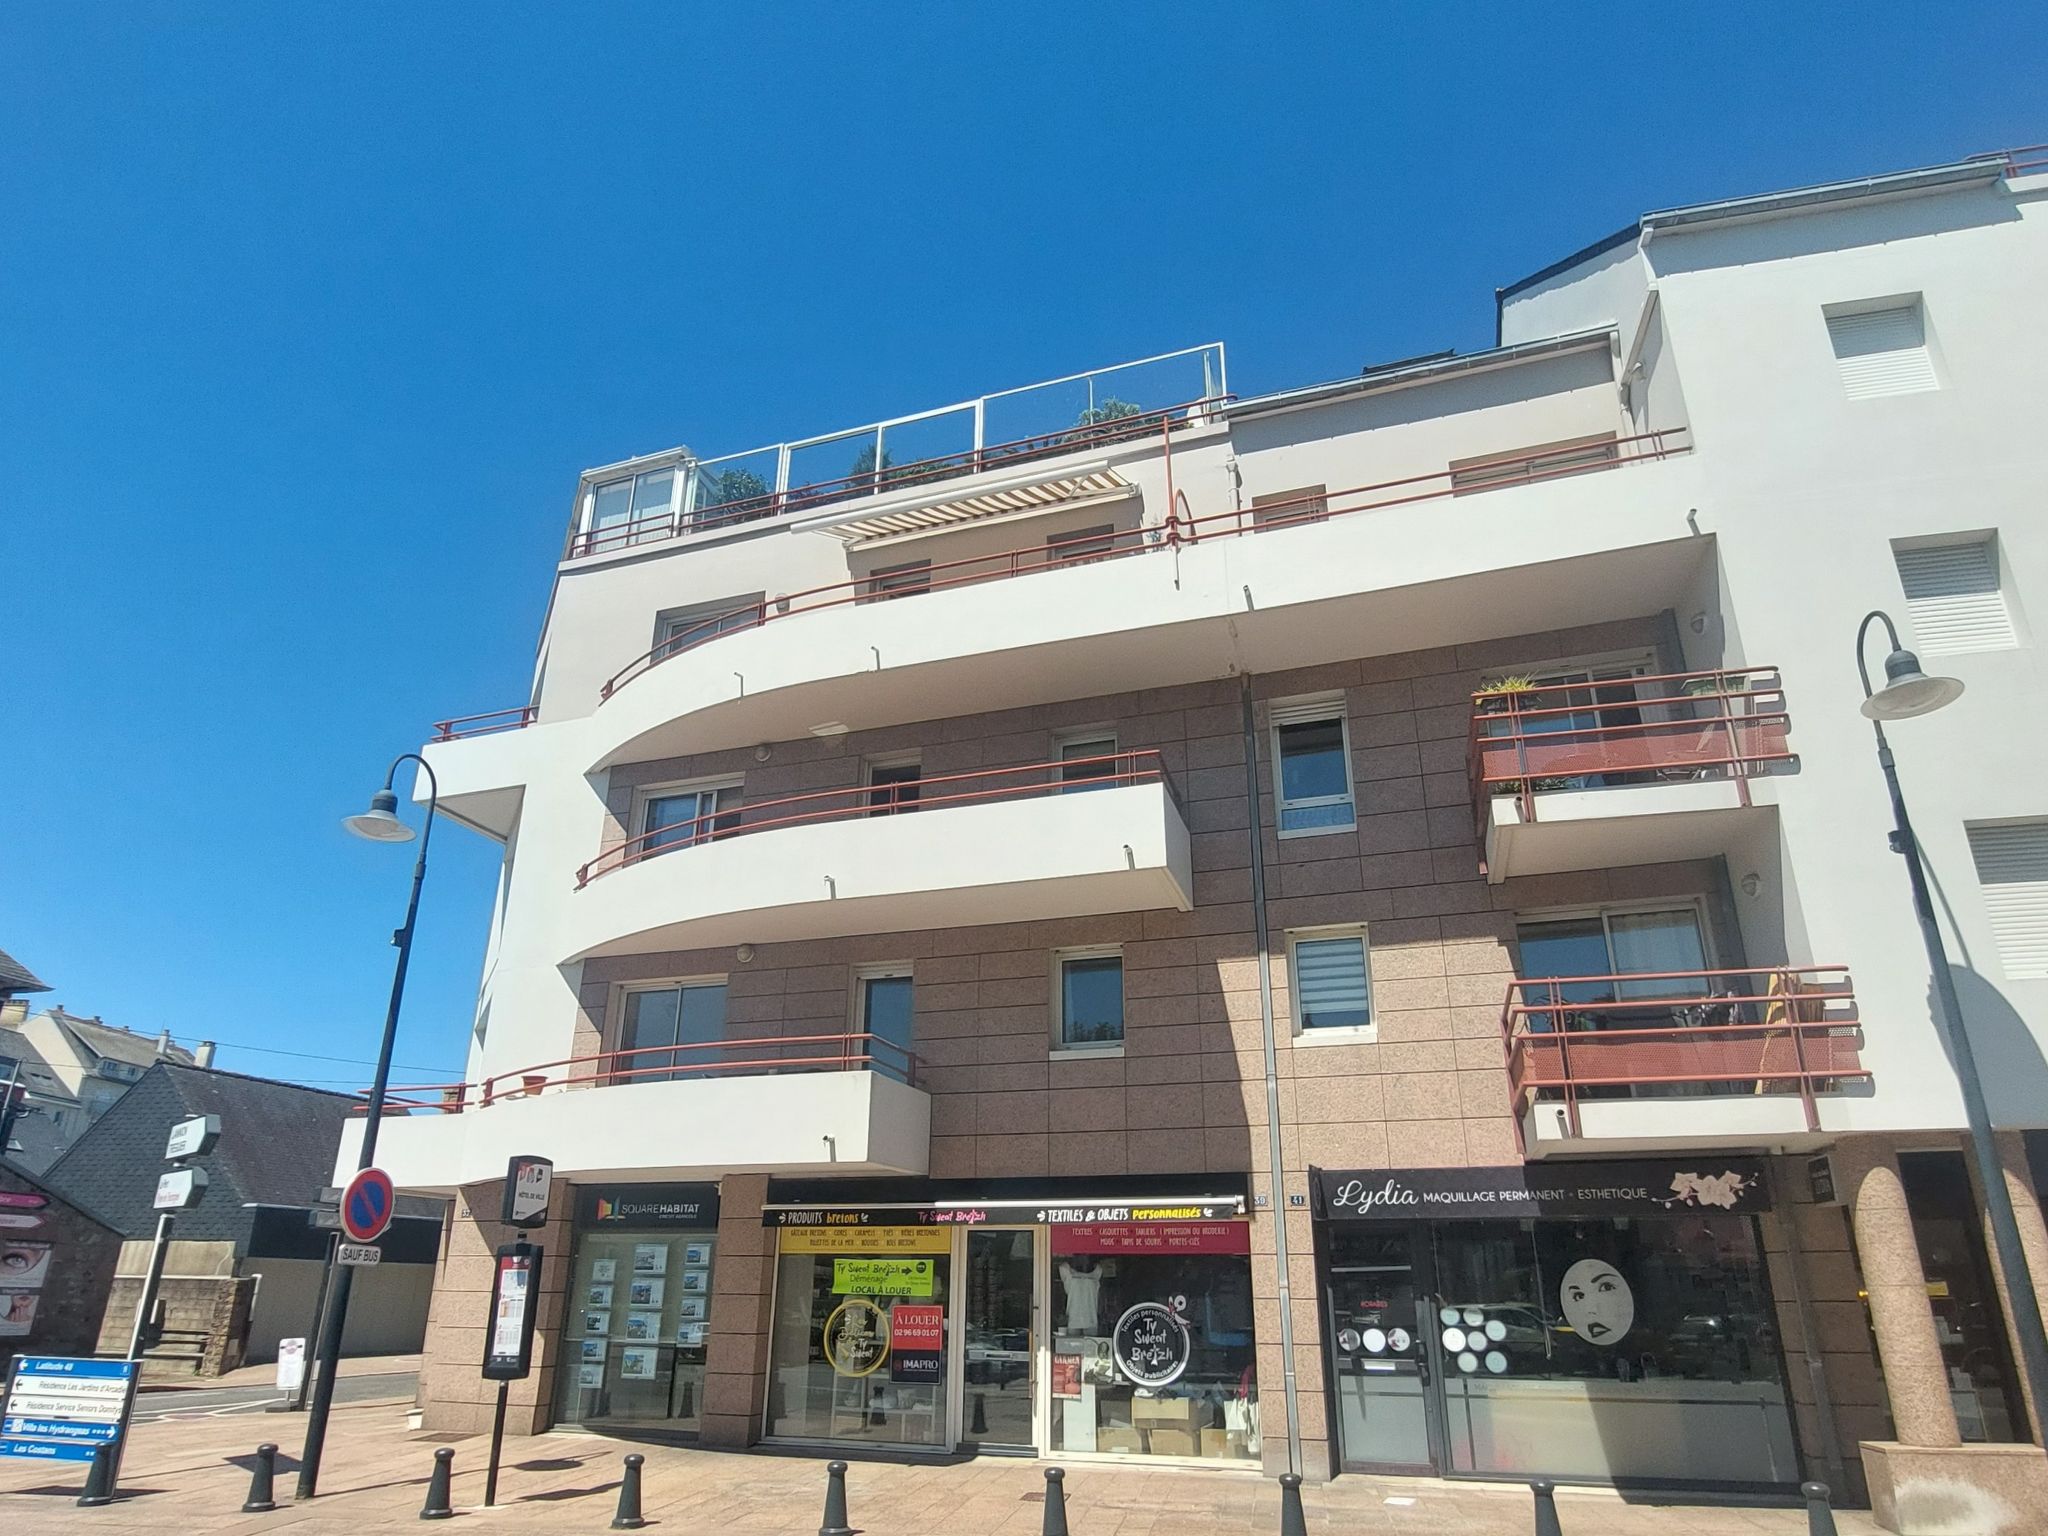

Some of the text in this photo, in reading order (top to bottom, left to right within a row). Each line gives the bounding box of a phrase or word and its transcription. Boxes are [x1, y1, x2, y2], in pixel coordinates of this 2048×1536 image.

[1292, 1196, 1302, 1204] 41
[1333, 1179, 1648, 1214] Lydia MAQUILLAGE PERMANENT ESTHETIQUE
[622, 1204, 700, 1214] SQUARE HABITAT
[788, 1211, 859, 1224] PRODUITS bretons
[917, 1208, 986, 1225] Ty Sweat Breizh
[1047, 1209, 1084, 1223] TEXTILES
[1085, 1209, 1096, 1222] &
[1097, 1208, 1129, 1221] OBJETS
[1099, 1228, 1128, 1236] CASQUETTES
[343, 1248, 379, 1262] SAUF BUS
[836, 1263, 846, 1274] Ty
[848, 1262, 870, 1273] Sweat
[850, 1274, 888, 1285] Déménage
[851, 1285, 876, 1294] LOCAL
[885, 1286, 912, 1295] LOUER
[896, 1312, 939, 1326] À LOUER
[1121, 1309, 1179, 1333] Textiles personnalisés
[1143, 1317, 1157, 1334] Ty
[930, 1329, 939, 1337] 07
[1134, 1328, 1167, 1345] Sweat
[858, 1338, 868, 1349] Ty
[850, 1346, 874, 1359] Sweat
[1131, 1343, 1173, 1366] Breizh
[35, 1361, 63, 1371] Latitude
[903, 1360, 939, 1370] IMAPRO
[1126, 1359, 1179, 1379] Objets publicitaires
[68, 1382, 78, 1391] Les
[78, 1382, 99, 1392] Jardins
[55, 1402, 76, 1411] Service
[23, 1422, 37, 1432] Villa
[13, 1444, 26, 1453] Les
